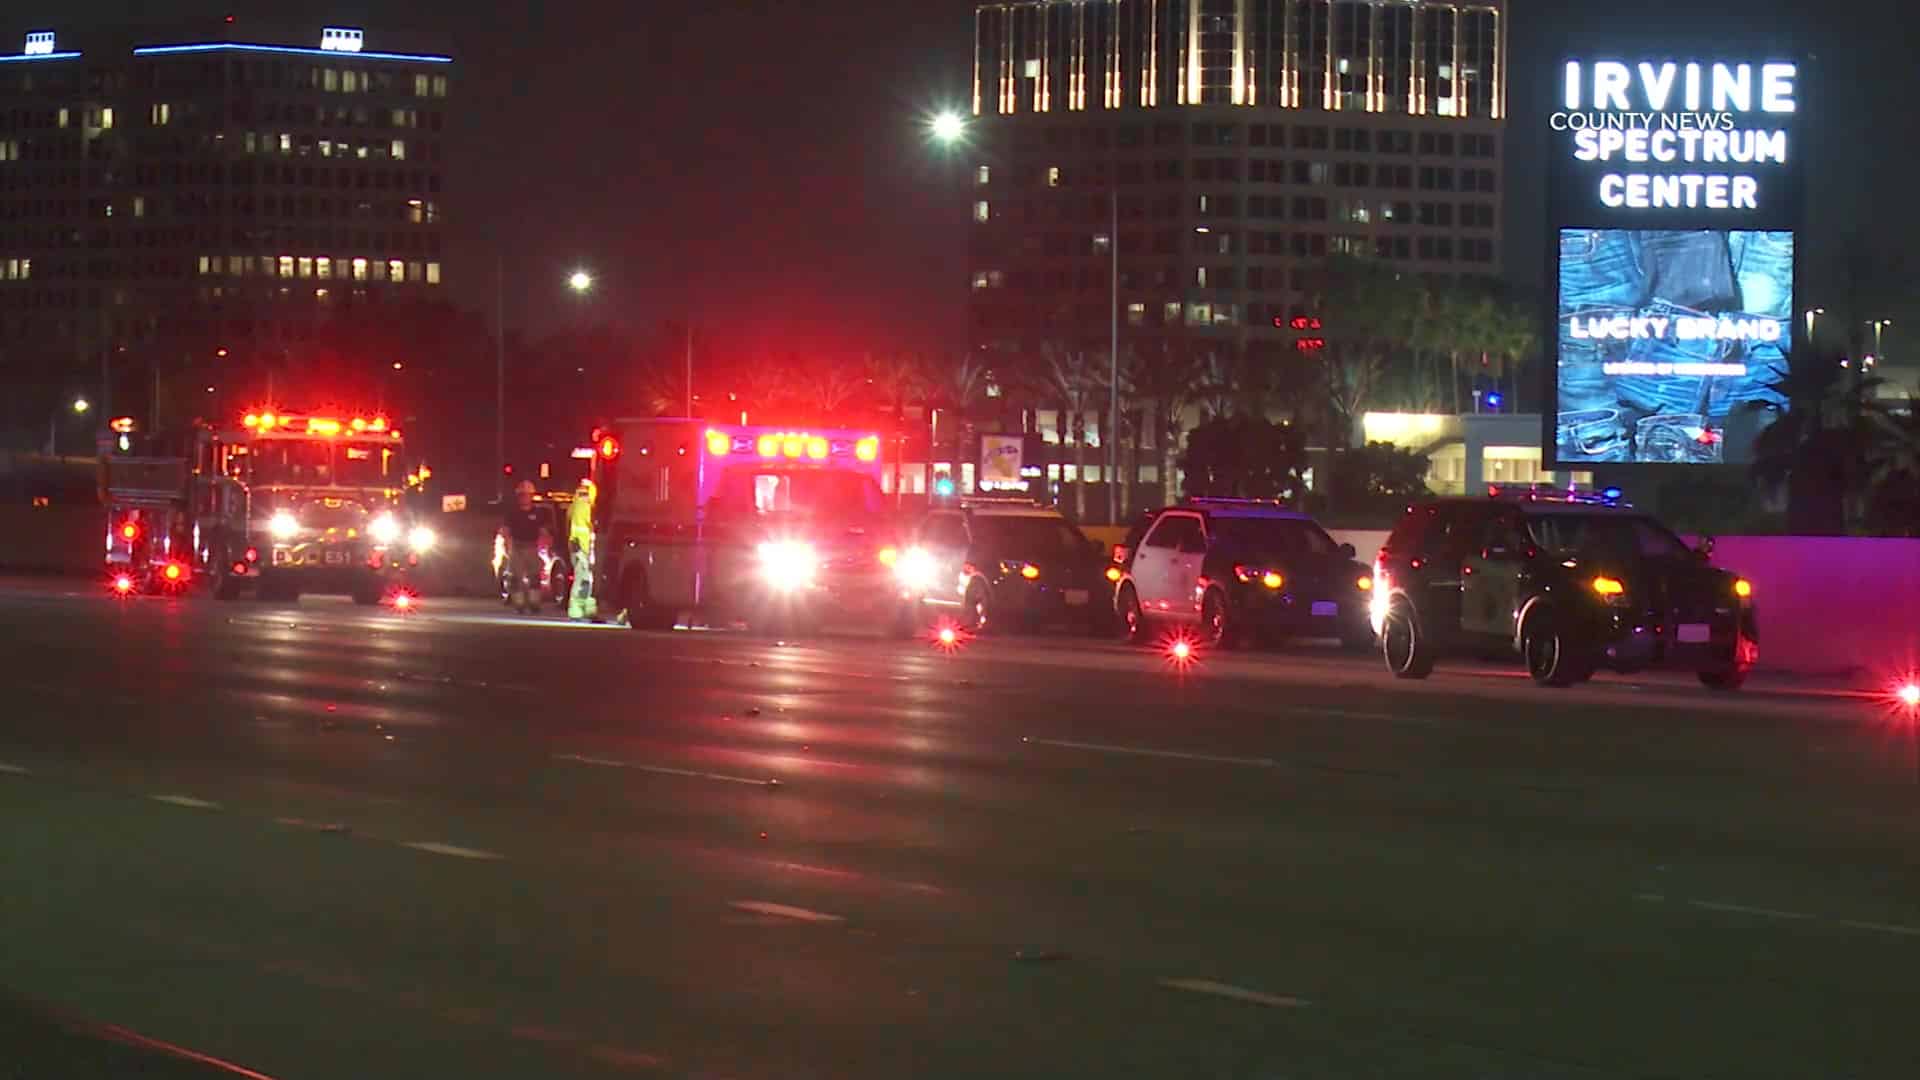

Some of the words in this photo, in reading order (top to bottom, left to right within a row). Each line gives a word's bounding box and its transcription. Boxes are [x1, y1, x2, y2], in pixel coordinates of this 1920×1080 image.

[1565, 61, 1796, 112] IRVINE
[1574, 128, 1786, 163] SPECTRUM
[1600, 174, 1758, 208] CENTER
[1569, 316, 1669, 339] LUCKY
[1676, 317, 1781, 341] BRAND
